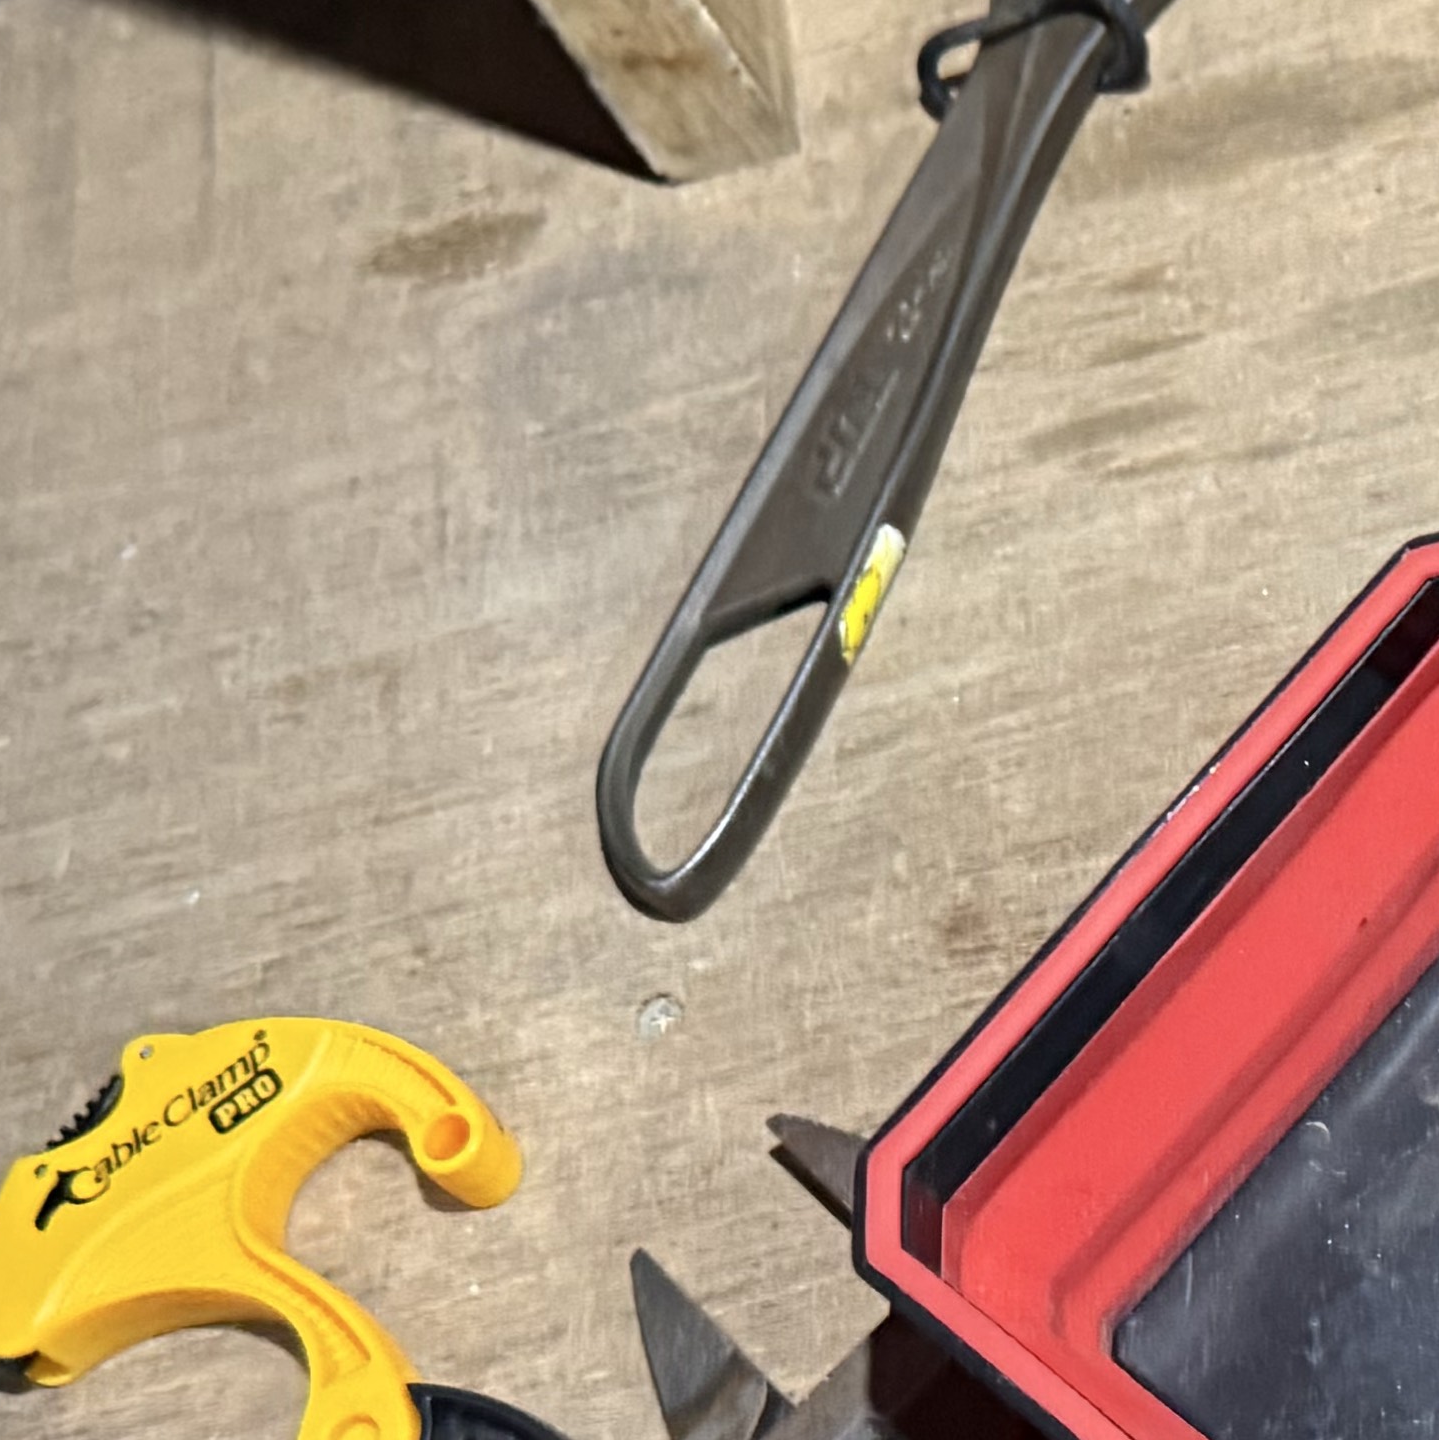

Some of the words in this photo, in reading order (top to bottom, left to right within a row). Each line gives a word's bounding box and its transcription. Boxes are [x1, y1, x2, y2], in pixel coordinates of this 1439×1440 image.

[53, 1121, 163, 1206] Cable
[163, 1041, 271, 1128] Clamp
[213, 1071, 278, 1130] PRO
